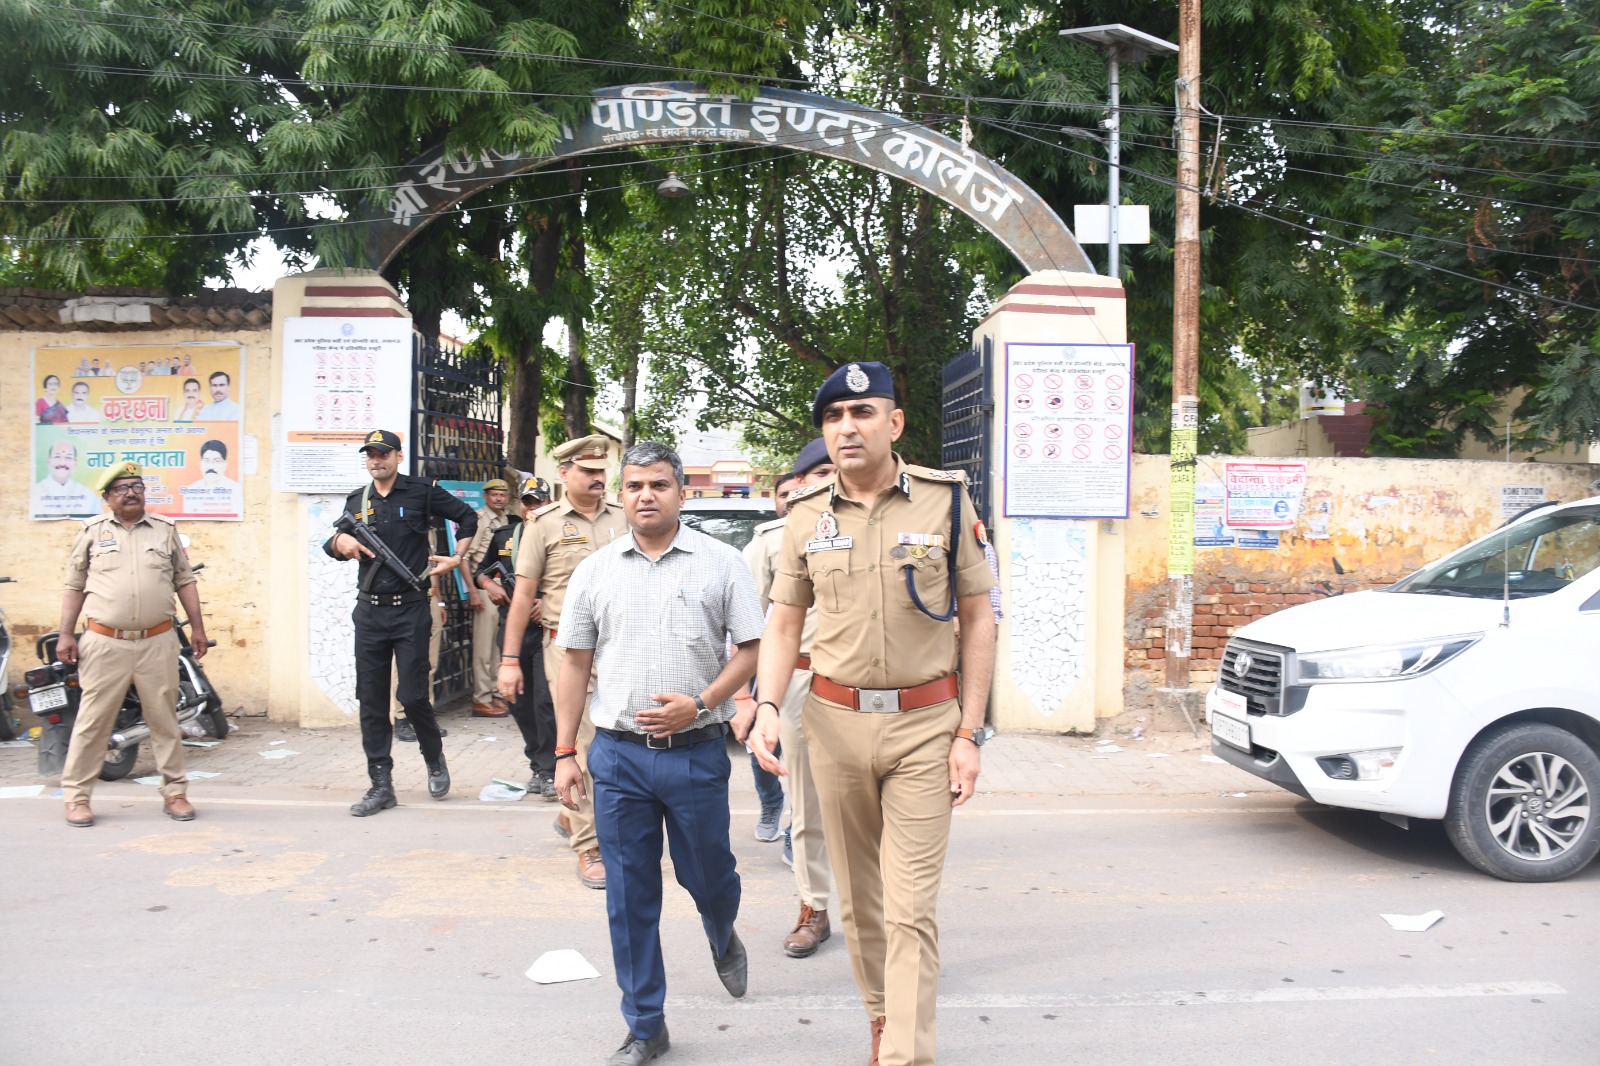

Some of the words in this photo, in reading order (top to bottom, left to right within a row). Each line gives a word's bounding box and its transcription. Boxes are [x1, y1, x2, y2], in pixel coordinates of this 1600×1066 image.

[750, 96, 883, 157] इण्टर
[882, 127, 1024, 222] कालेज
[103, 396, 168, 419] करछना
[86, 450, 115, 468] नए
[121, 450, 187, 468] मतदाता
